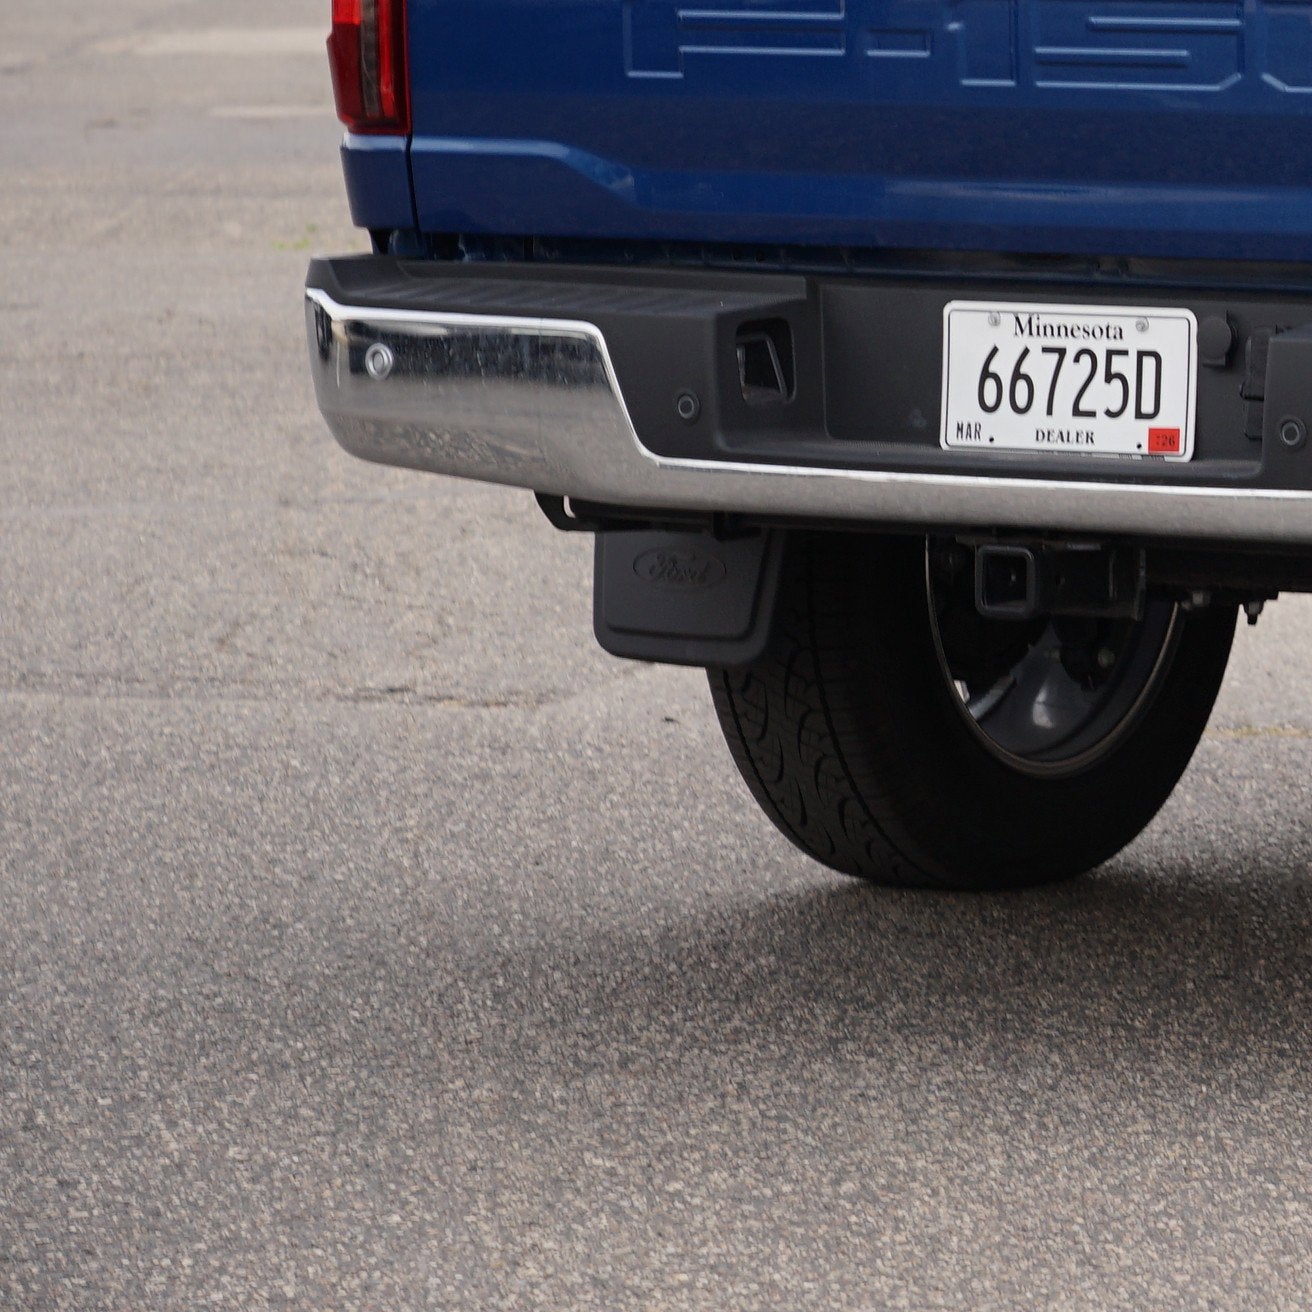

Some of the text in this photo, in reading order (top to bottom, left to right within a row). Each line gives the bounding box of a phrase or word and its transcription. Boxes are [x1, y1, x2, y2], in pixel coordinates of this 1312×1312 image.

[1013, 313, 1124, 340] Minnesota
[977, 344, 1163, 419] 66725D
[956, 422, 982, 440] MAR
[1035, 428, 1096, 445] DEALER
